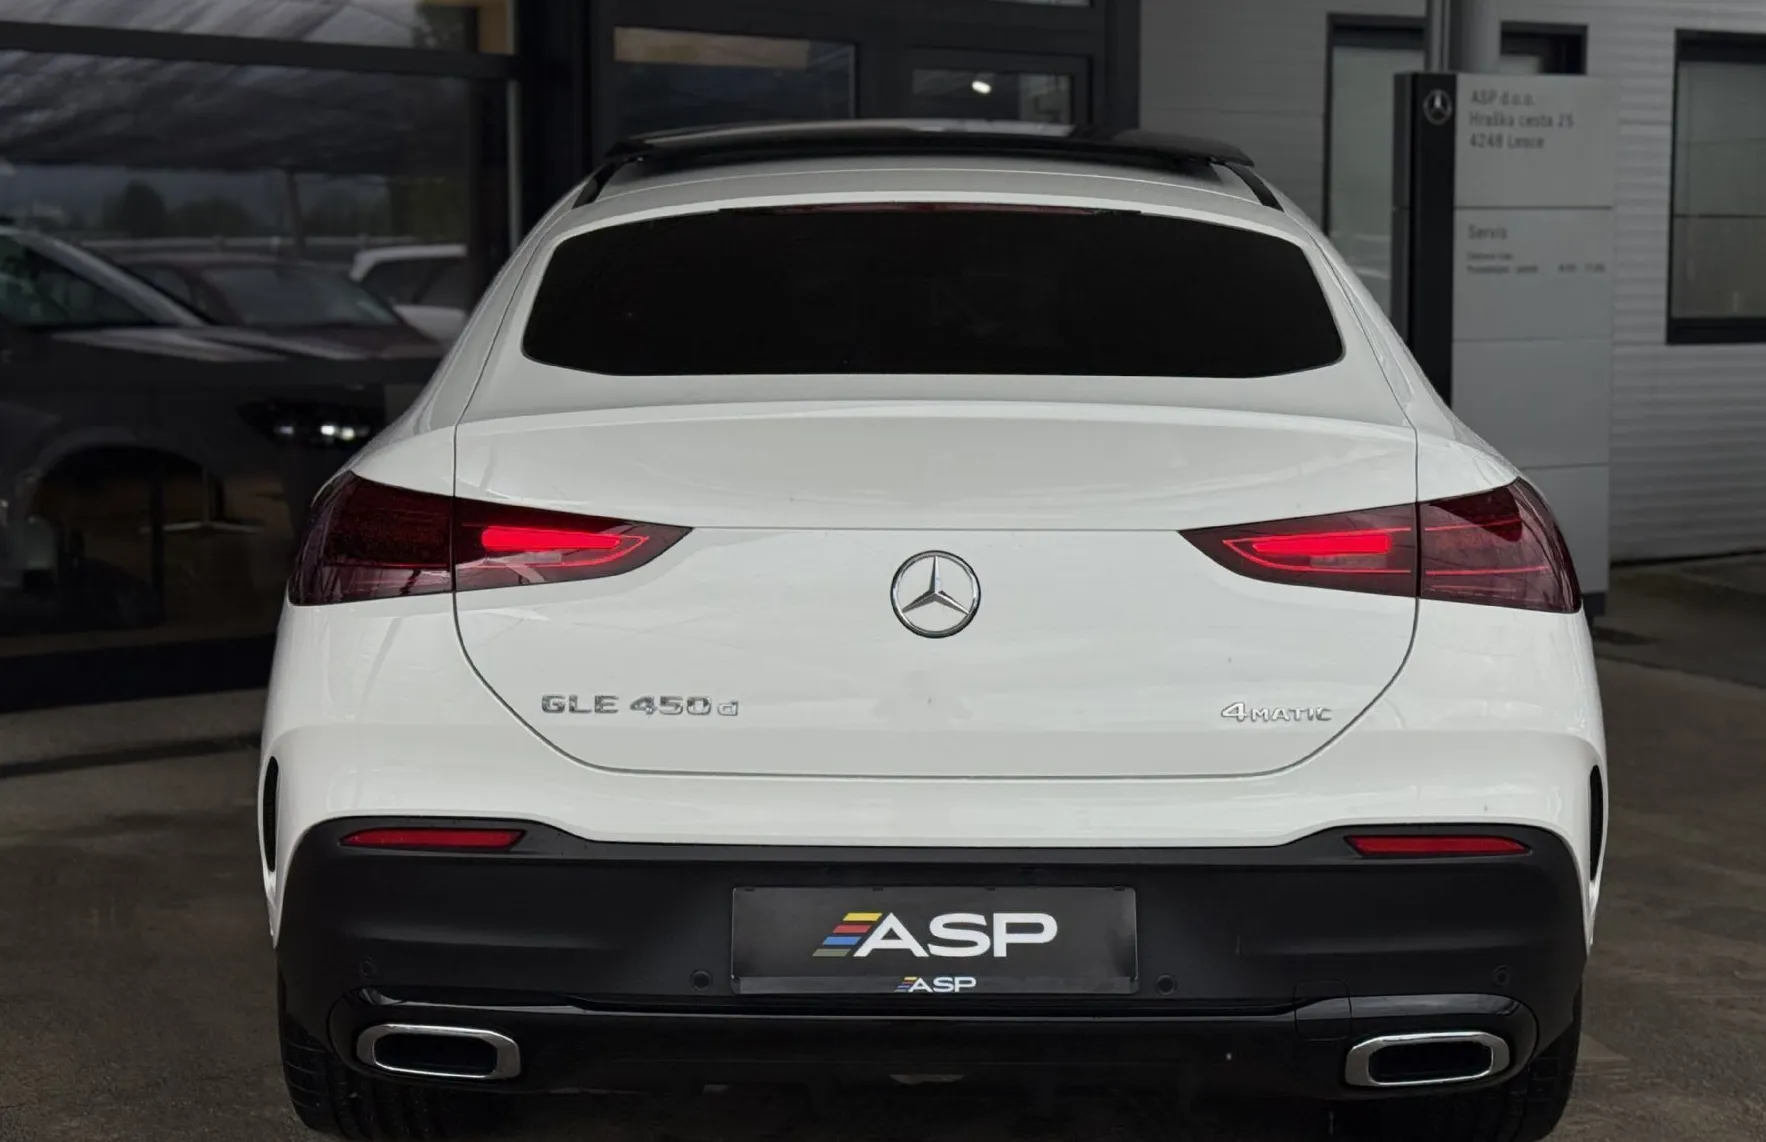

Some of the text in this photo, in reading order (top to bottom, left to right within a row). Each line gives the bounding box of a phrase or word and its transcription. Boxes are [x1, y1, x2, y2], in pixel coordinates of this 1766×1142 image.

[541, 695, 619, 714] GLE
[1221, 701, 1332, 722] 4MATIC
[853, 912, 1058, 957] ASP
[908, 976, 977, 993] ASP
